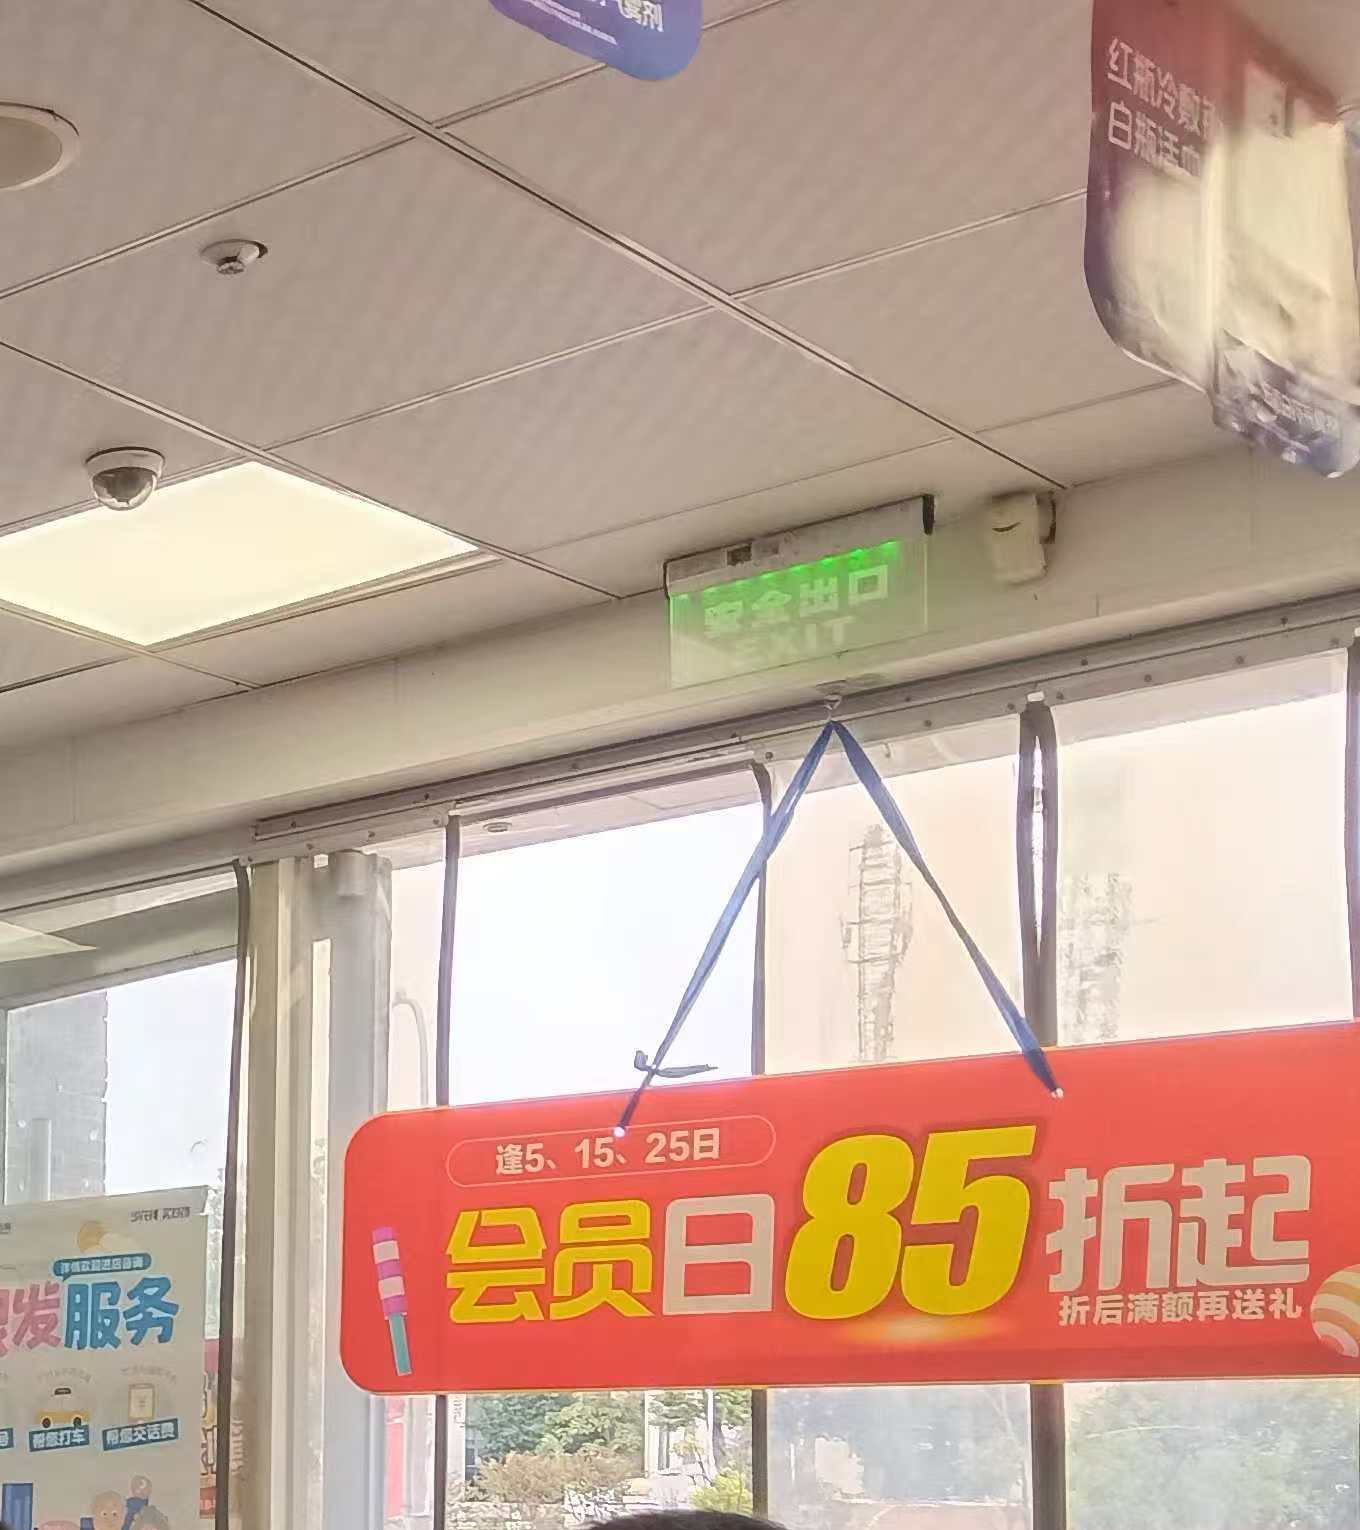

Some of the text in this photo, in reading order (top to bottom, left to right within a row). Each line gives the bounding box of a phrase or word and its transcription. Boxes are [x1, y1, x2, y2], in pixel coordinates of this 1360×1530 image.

[495, 1127, 721, 1177] 逢5、15、25日
[783, 1124, 1037, 1322] 85
[1045, 1154, 1312, 1293] 折起
[1057, 1288, 1304, 1327] 折后满额再送礼
